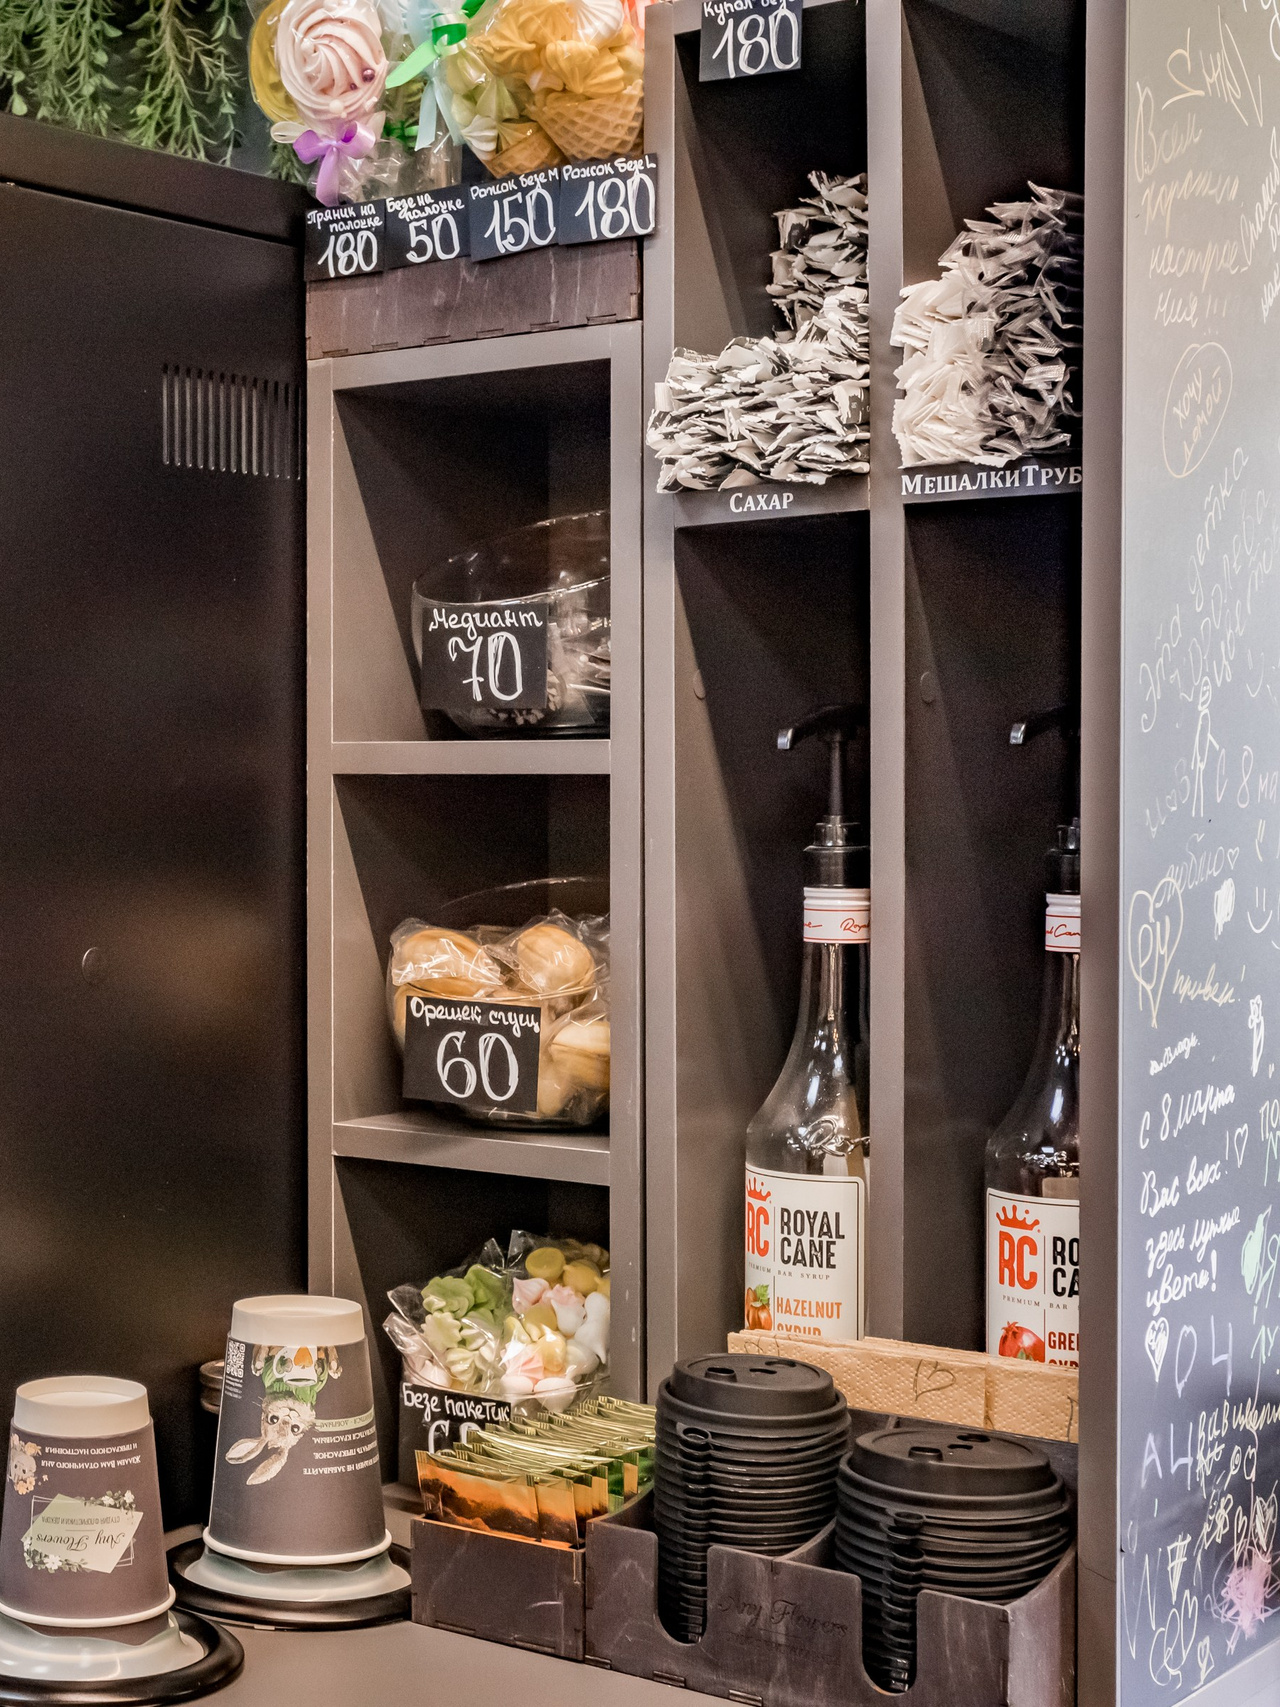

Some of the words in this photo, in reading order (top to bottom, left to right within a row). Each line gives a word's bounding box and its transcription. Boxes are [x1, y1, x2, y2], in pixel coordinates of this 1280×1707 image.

[712, 9, 799, 78] 180
[307, 206, 356, 230] Пряник
[360, 203, 377, 216] на
[385, 197, 417, 219] Безе
[417, 193, 435, 206] на
[404, 199, 465, 222] палочке
[574, 173, 656, 240] 180
[329, 216, 383, 233] палочке
[484, 188, 556, 254] 150
[406, 213, 460, 264] 50
[317, 230, 378, 278] 180
[448, 631, 523, 702] 70
[410, 996, 482, 1026] Орешек
[436, 1030, 519, 1101] 60
[1160, 1093, 1172, 1141] 8
[747, 1201, 770, 1257] RC
[780, 1207, 845, 1240] ROYAL
[780, 1237, 837, 1269] CANE
[998, 1230, 1038, 1290] RC
[777, 1269, 793, 1277] BAR
[776, 1296, 842, 1320] HAZELNUT
[1002, 1294, 1040, 1307] PREMIUM
[1049, 1302, 1068, 1310] BAR
[1048, 1331, 1080, 1351] GRE
[403, 1382, 441, 1421] Безе
[41, 1460, 56, 1469] ДНЯ
[45, 1447, 89, 1455] НАСТРОЕНИЯ
[56, 1461, 100, 1469] ОТЛИЧНОГО
[303, 1466, 346, 1475] ЗАБЫВАЙТЕ
[36, 1533, 89, 1552] Flowers
[95, 1529, 126, 1550] Any
